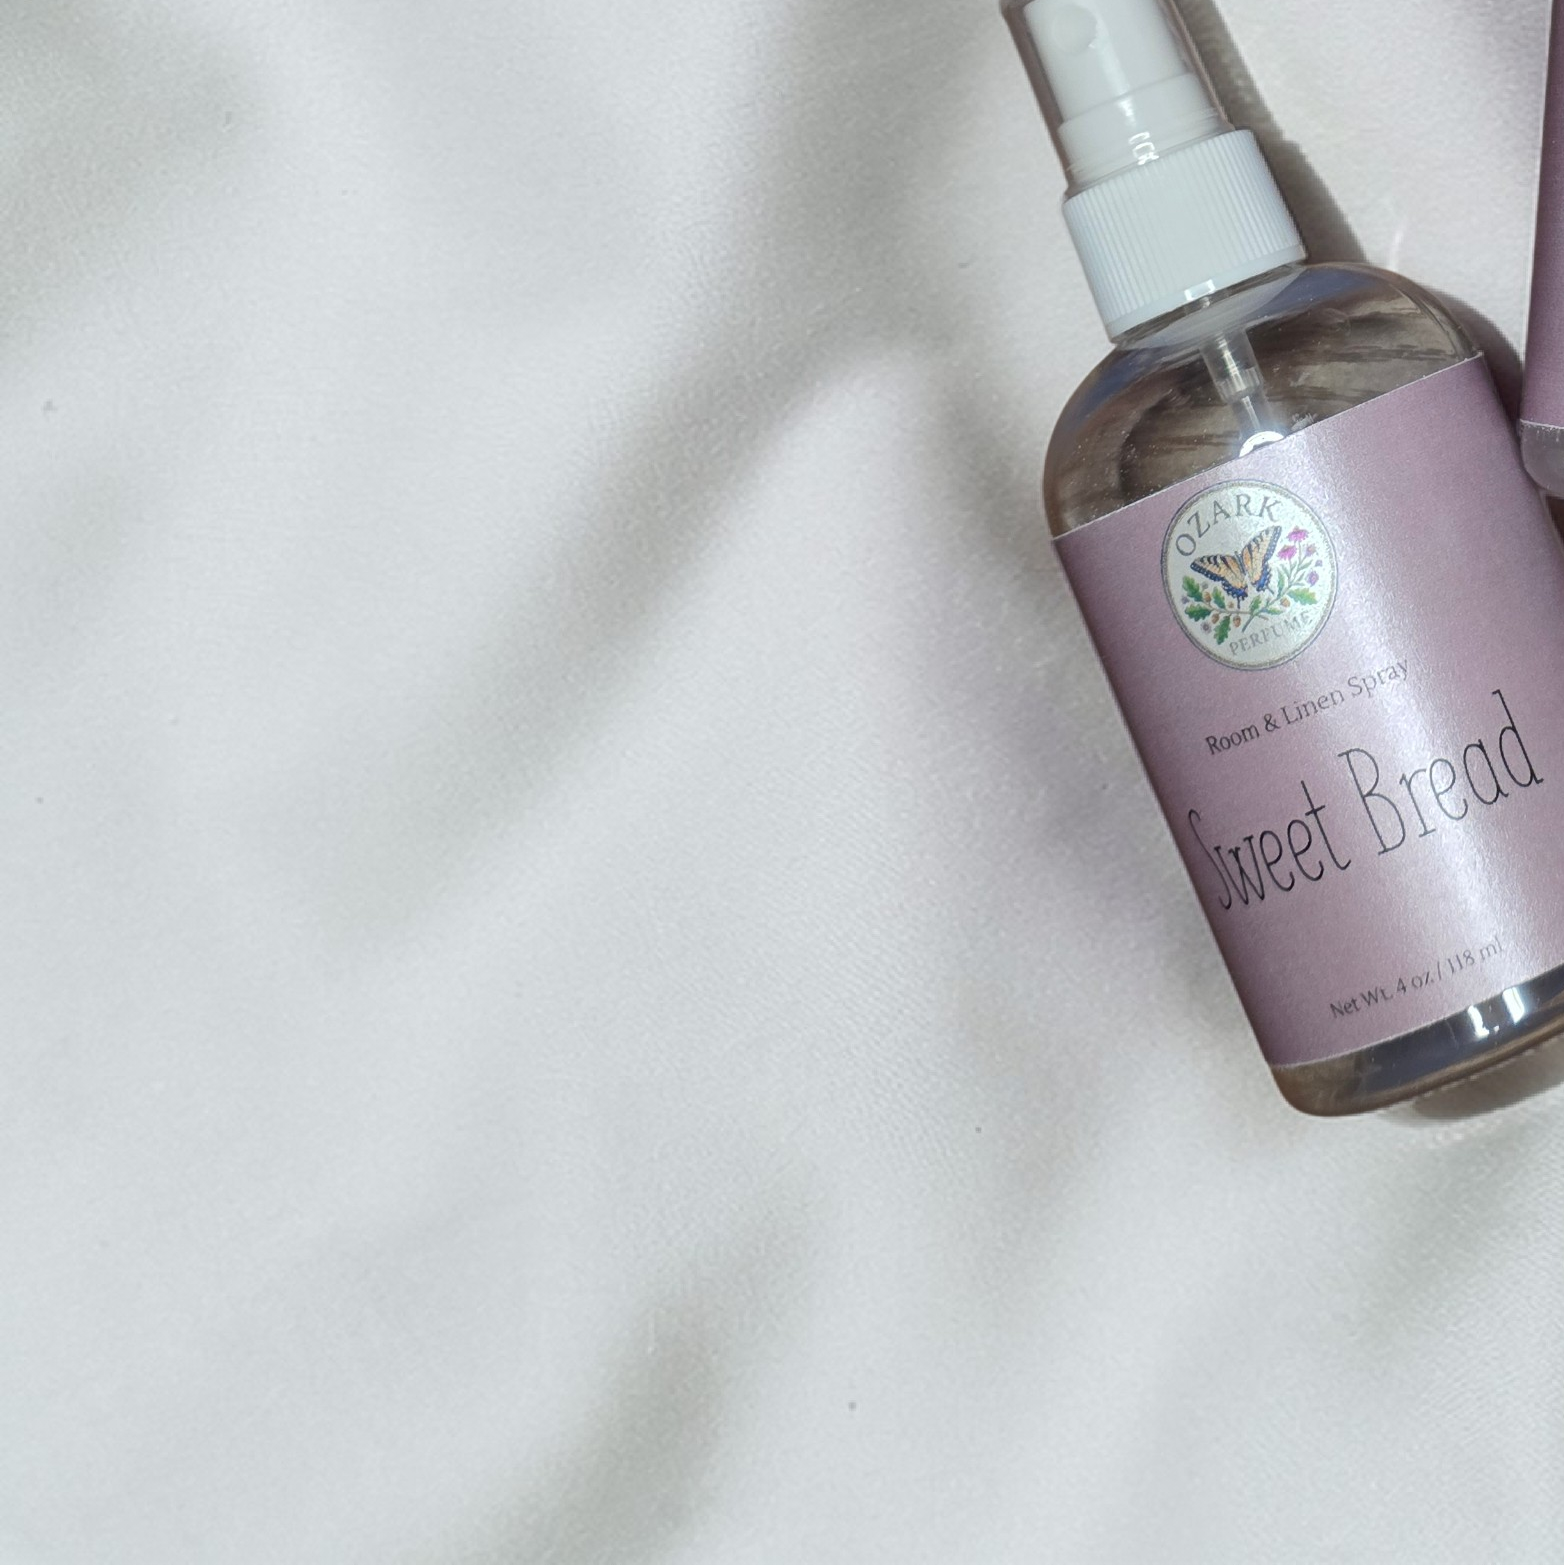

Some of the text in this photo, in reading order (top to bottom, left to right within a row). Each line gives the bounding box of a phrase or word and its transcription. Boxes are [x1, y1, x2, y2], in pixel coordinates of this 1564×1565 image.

[1175, 493, 1282, 557] OZARK
[1228, 612, 1313, 657] PERFUME
[1206, 659, 1410, 755] Room & Linen Spray
[1188, 688, 1545, 910] Sweet Bread
[1330, 999, 1360, 1018] Net
[1361, 987, 1393, 1007] Wt.
[1396, 978, 1408, 995] 4
[1411, 971, 1434, 989] oz
[1447, 950, 1476, 974] 118
